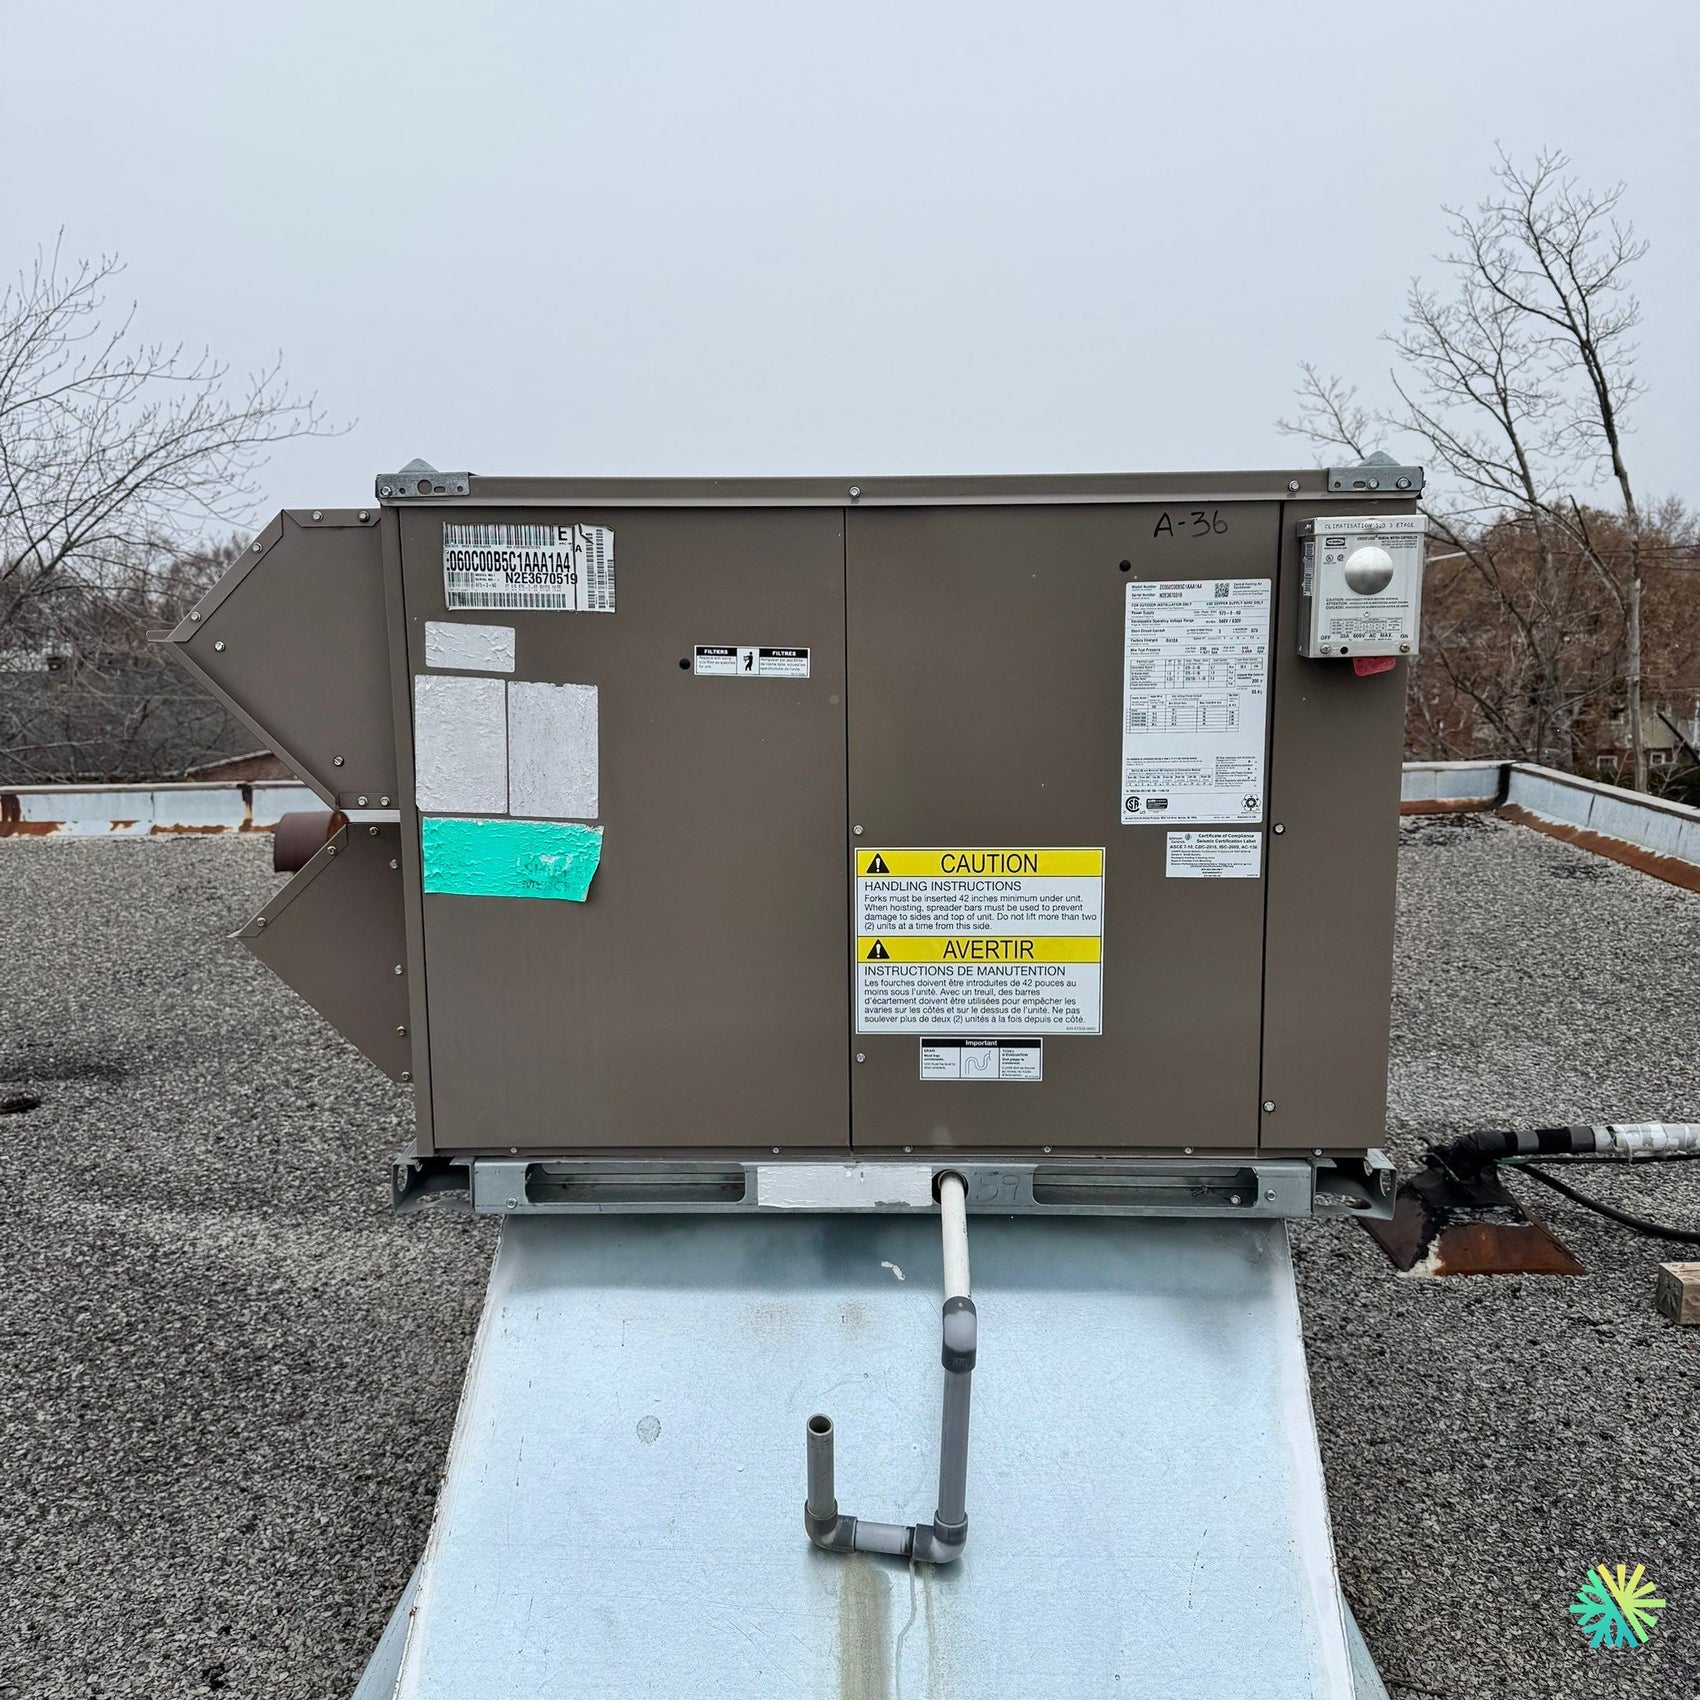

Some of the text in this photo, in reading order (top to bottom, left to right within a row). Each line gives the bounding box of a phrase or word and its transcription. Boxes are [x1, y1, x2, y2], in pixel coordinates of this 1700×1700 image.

[1154, 510, 1228, 538] A-36
[575, 544, 582, 552] A
[446, 550, 570, 572] 060C00B5C1AAA1A4
[505, 572, 578, 584] N2E3670519
[941, 853, 1037, 873] CAUTION
[865, 881, 1022, 892] HANDLING INSTRUCTIONS
[864, 894, 887, 902] Forks
[924, 894, 957, 902] inserted
[959, 894, 969, 902] 42
[971, 894, 998, 902] inches
[1000, 894, 1038, 902] minimum
[1040, 894, 1064, 902] under
[864, 904, 888, 912] When
[890, 904, 924, 913] hoisting,
[926, 904, 962, 913] spreader
[1052, 904, 1083, 913] prevent
[864, 913, 897, 923] damage
[951, 914, 966, 923] top
[864, 922, 874, 931] (2)
[943, 940, 1034, 959] AVERTIR
[865, 966, 1065, 976] INSTRUCTIONS DE MANUTENTION
[880, 978, 915, 987] fourches
[948, 978, 964, 987] être
[966, 979, 1008, 987] introduites
[1010, 979, 1020, 987] de
[1022, 978, 1033, 987] 42
[1034, 980, 1064, 988] pouces
[974, 988, 996, 997] treuil,
[950, 996, 966, 1005] être
[1002, 998, 1020, 1006] pour
[1022, 997, 1063, 1006] empêcher
[1064, 997, 1076, 1006] les
[864, 1006, 892, 1014] avaries
[922, 1006, 945, 1014] côtés
[971, 1006, 978, 1014] le
[980, 1006, 1009, 1014] dessus
[1023, 1006, 1050, 1014] l'unité.
[1052, 1006, 1064, 1014] Ne
[900, 1015, 917, 1024] plus
[953, 1015, 963, 1024] (2)
[1024, 1015, 1052, 1024] depuis
[1065, 1015, 1085, 1023] côté.
